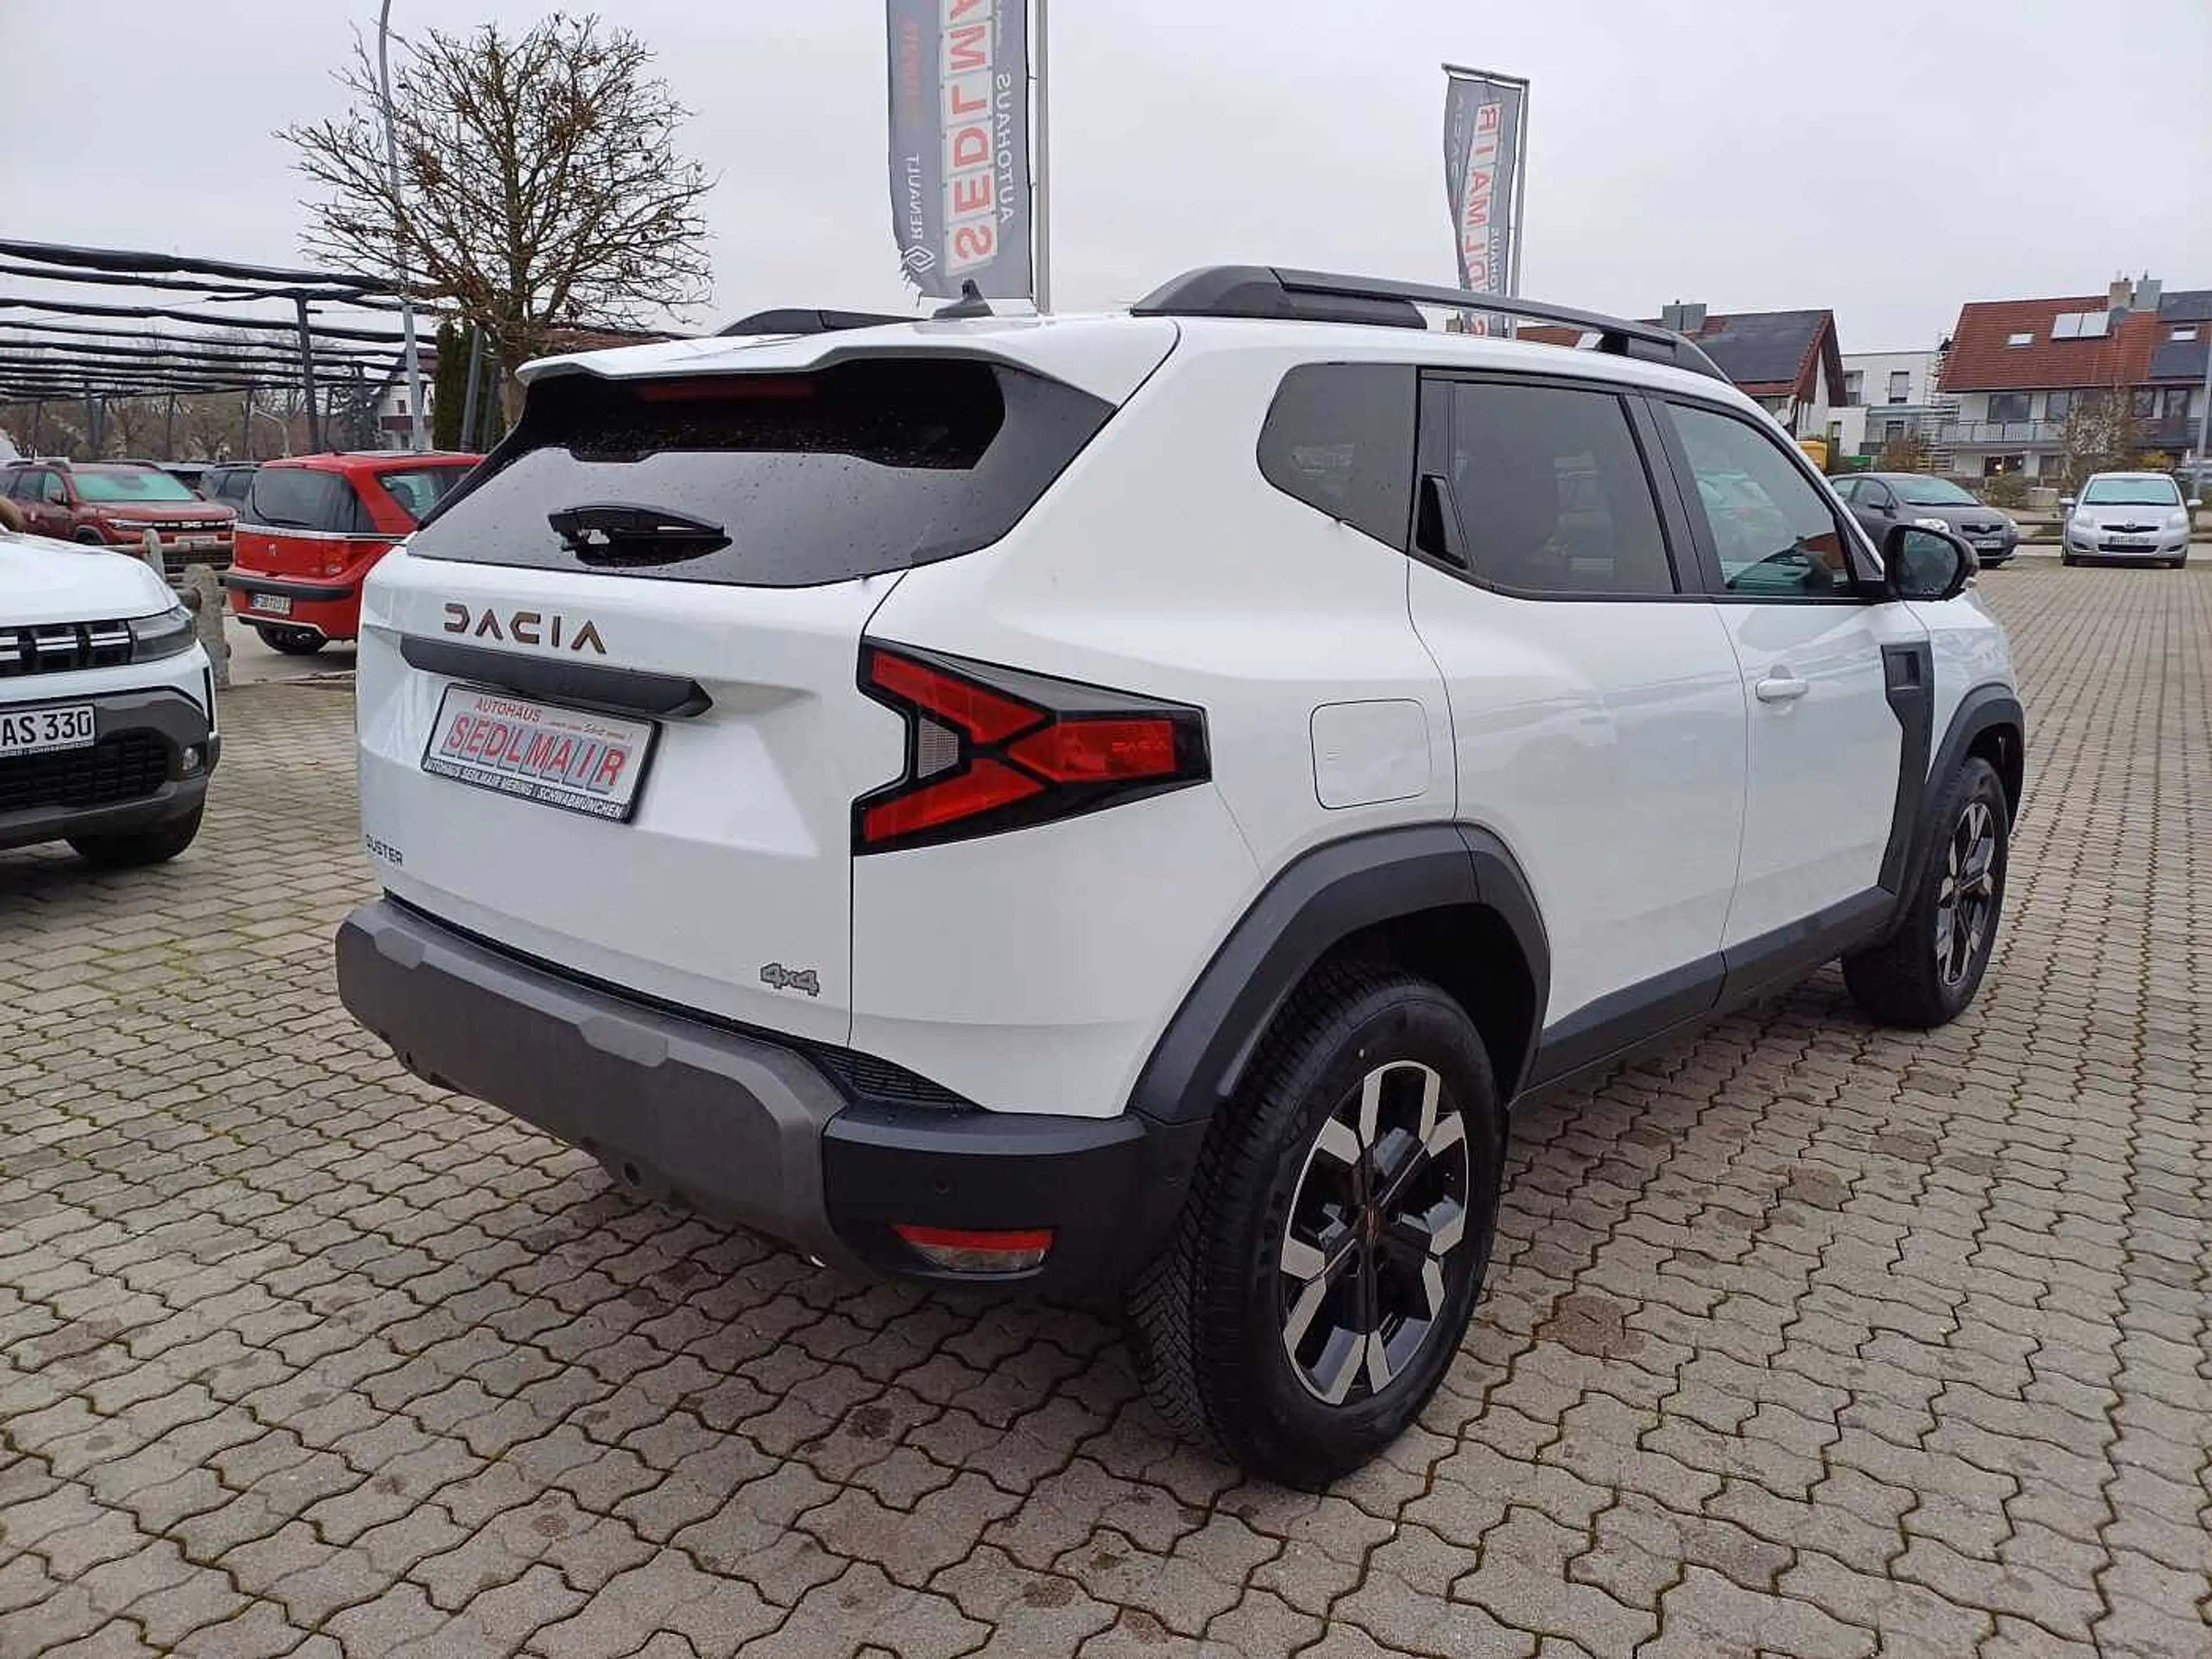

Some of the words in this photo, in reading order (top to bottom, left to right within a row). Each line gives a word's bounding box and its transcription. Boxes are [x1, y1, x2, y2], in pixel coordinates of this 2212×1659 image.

[444, 603, 607, 655] DACIA
[2, 716, 36, 747] AS
[43, 711, 92, 741] 330
[475, 696, 542, 722] AUTOHAUS
[448, 716, 626, 786] SEDLMAIR
